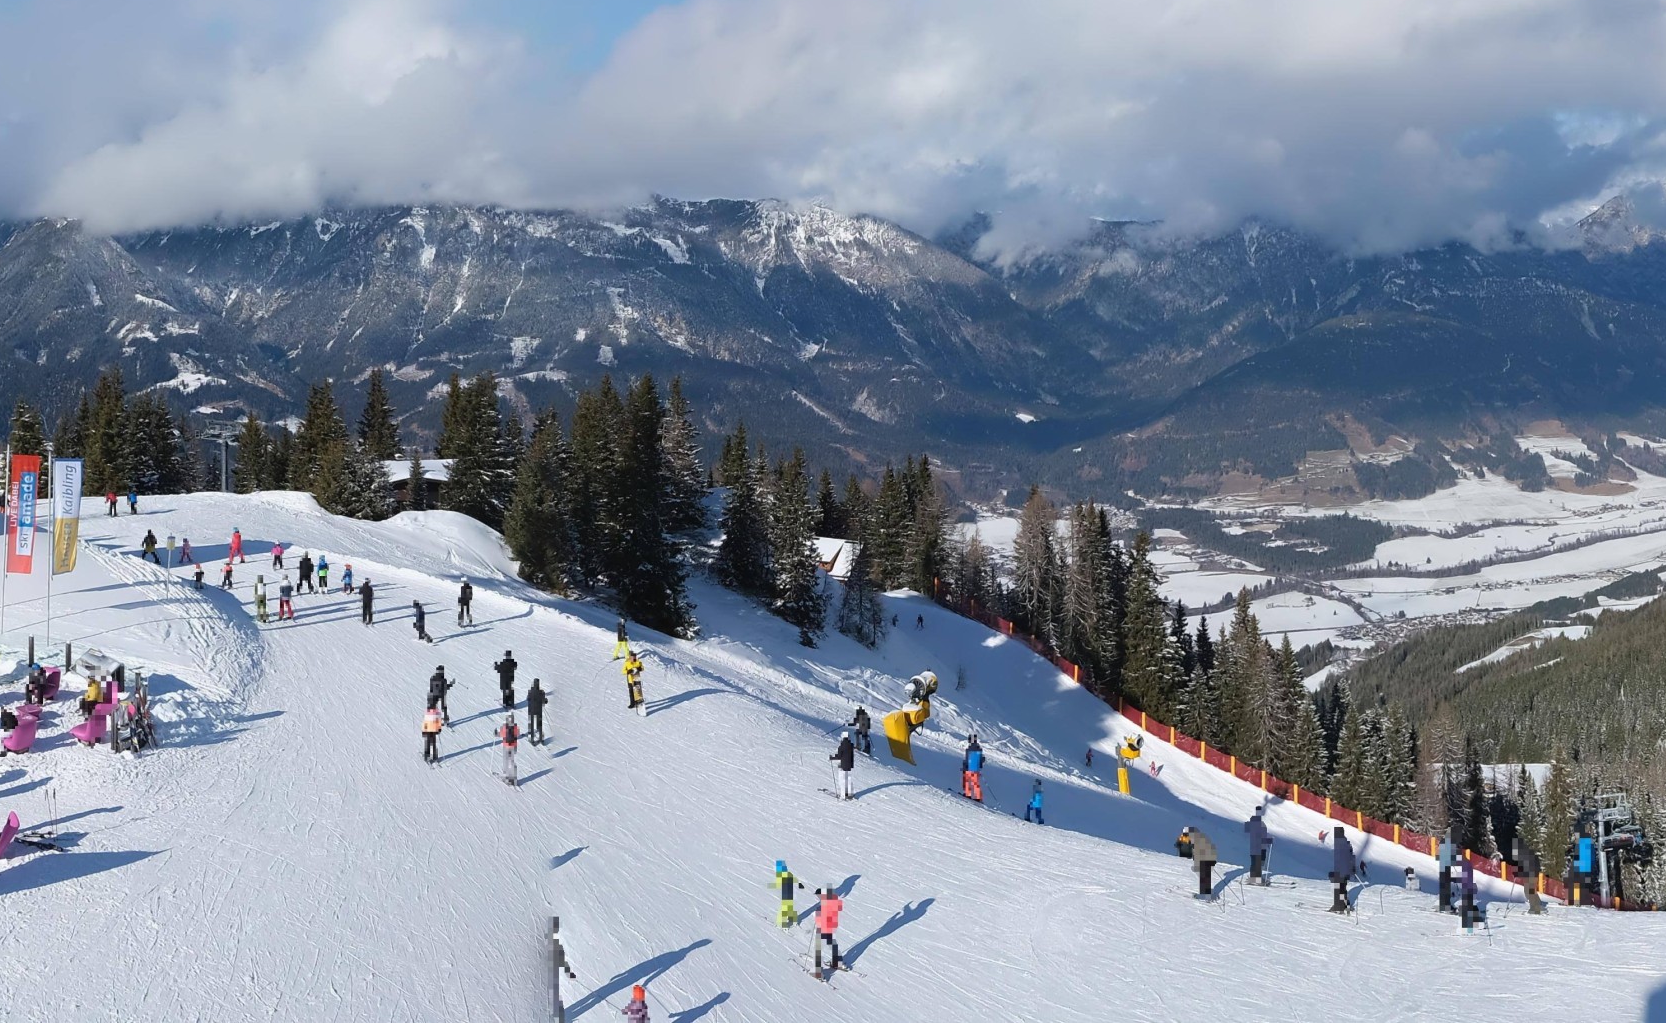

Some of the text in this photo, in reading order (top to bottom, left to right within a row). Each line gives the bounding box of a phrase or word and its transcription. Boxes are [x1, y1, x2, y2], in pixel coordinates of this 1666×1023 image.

[10, 508, 18, 527] LIVE
[60, 464, 77, 568] HAUSER Kaibling
[20, 532, 30, 549] Ski
